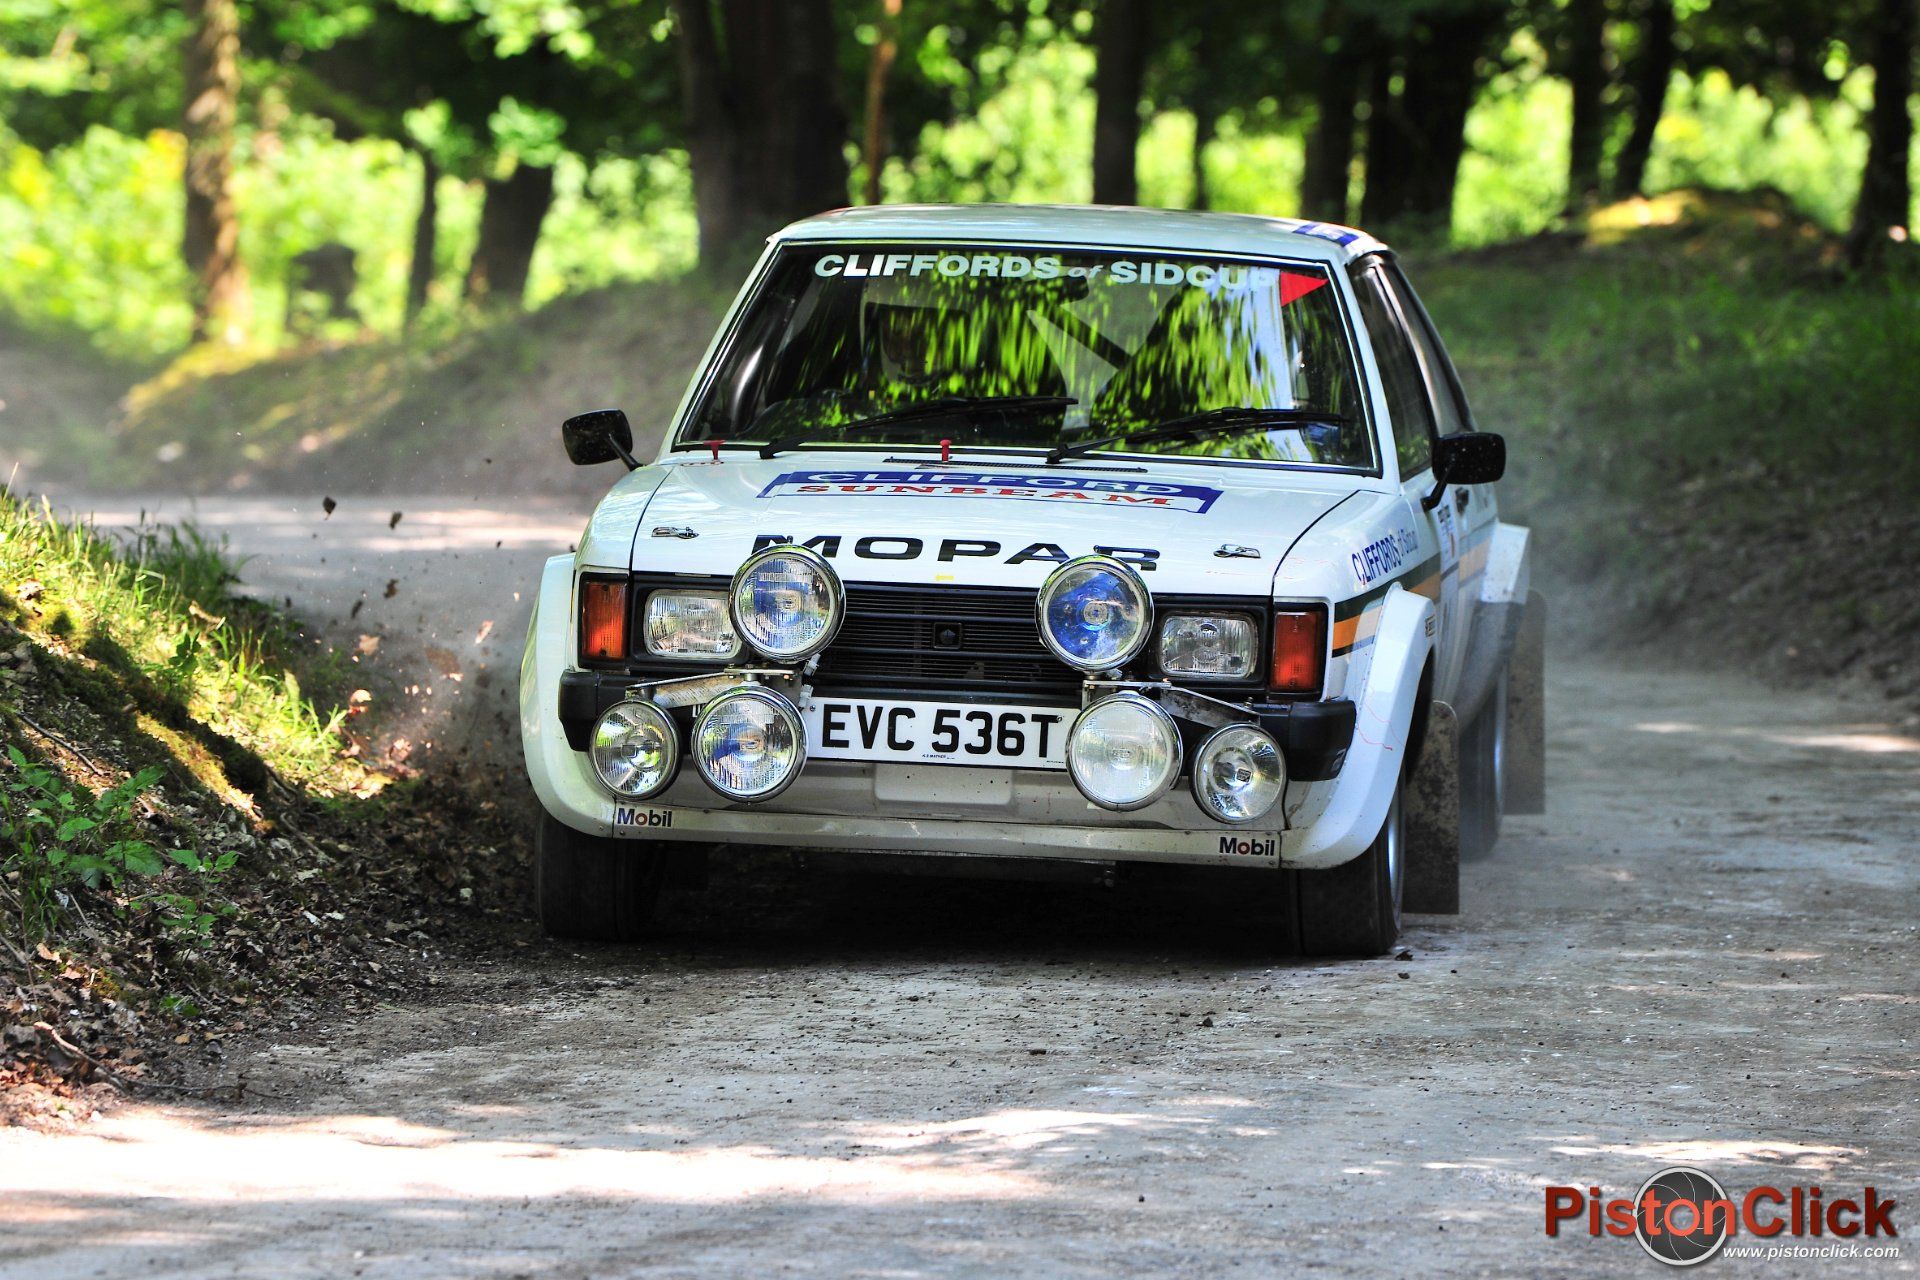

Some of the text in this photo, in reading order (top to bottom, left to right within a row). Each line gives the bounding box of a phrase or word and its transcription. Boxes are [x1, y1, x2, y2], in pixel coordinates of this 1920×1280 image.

[814, 253, 1275, 290] CLIFFORDS of SIDCUP
[796, 483, 1175, 507] SUNBEAM
[806, 471, 1183, 494] CLIFFORD
[750, 534, 1161, 572] MOPAR
[1351, 533, 1402, 586] CLIFFORDS
[821, 703, 1061, 759] EVC 536T
[616, 807, 673, 828] Mobil
[1218, 836, 1275, 857] Mobil
